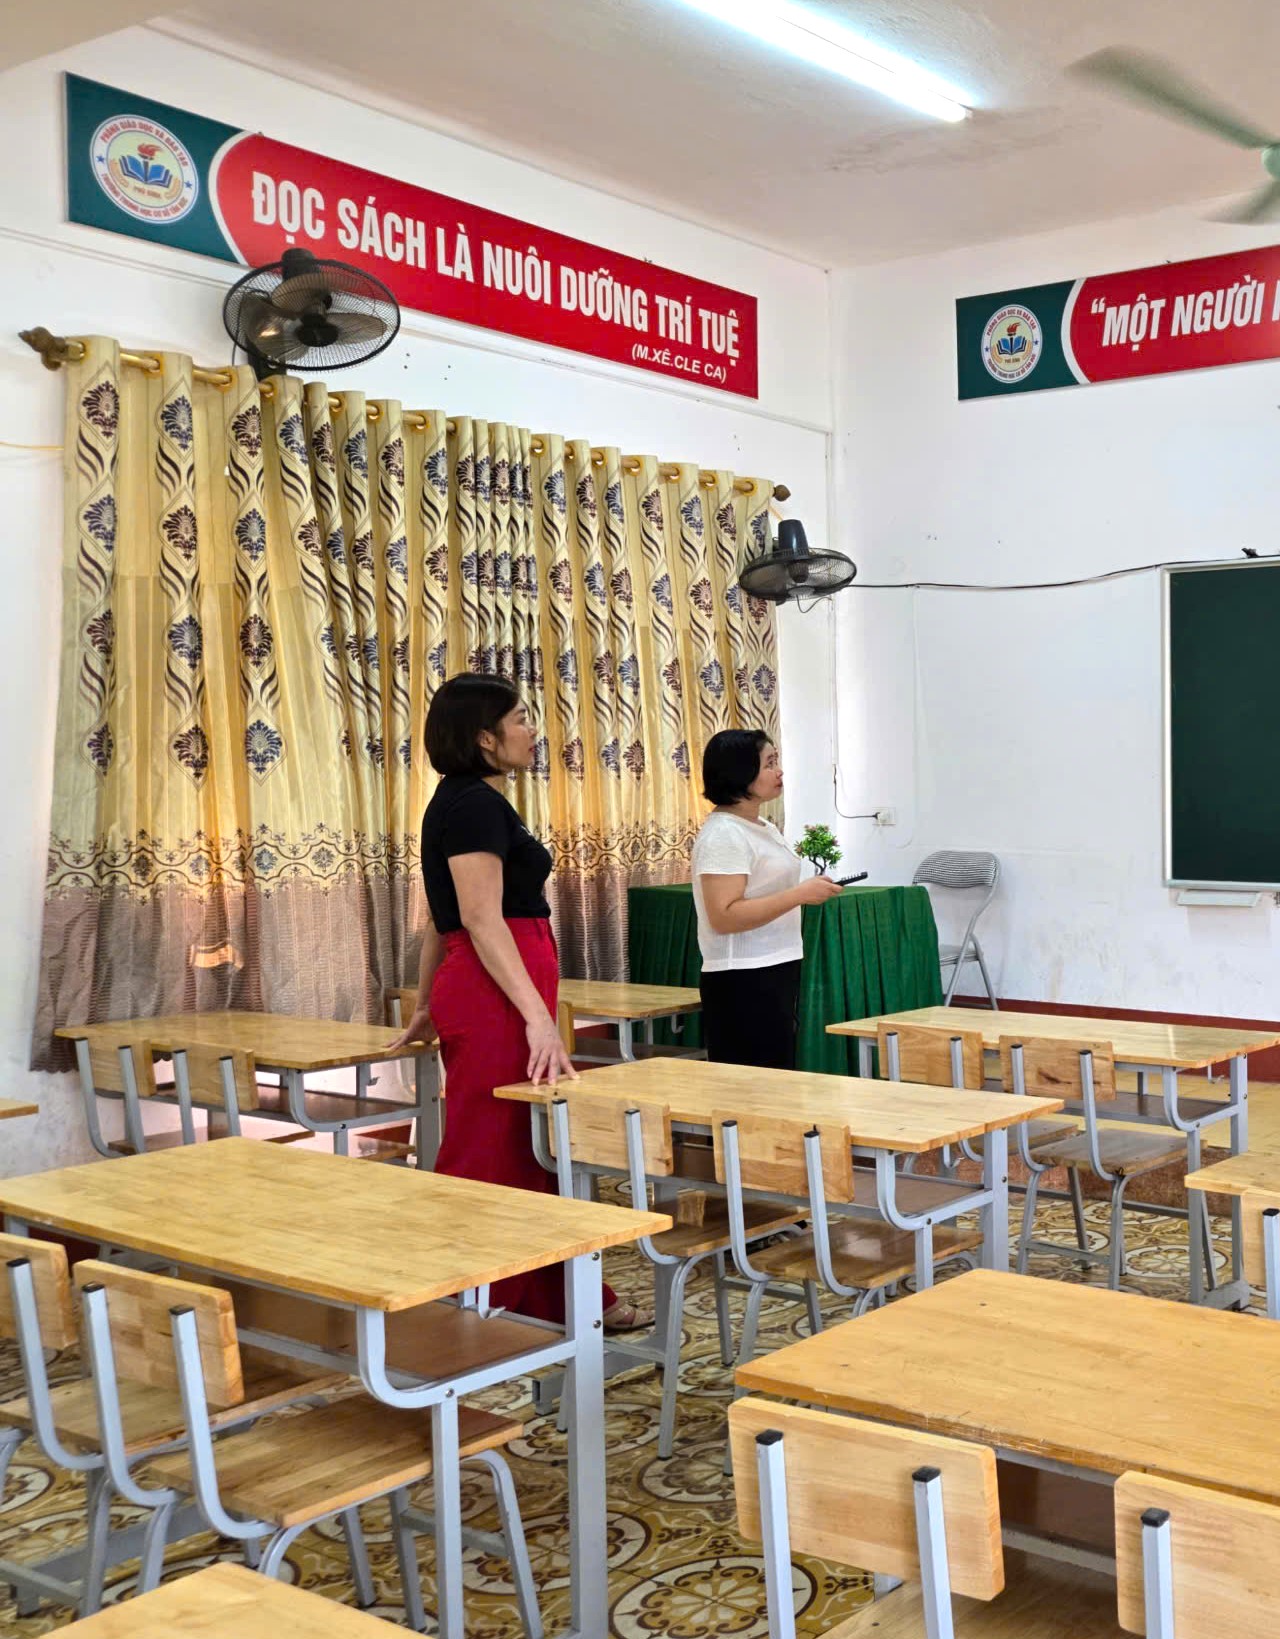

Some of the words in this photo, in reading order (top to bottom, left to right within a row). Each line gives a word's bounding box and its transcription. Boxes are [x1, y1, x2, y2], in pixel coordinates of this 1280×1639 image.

[251, 171, 325, 245] ĐỌC
[337, 196, 427, 269] SÁCH
[436, 222, 475, 283] LÀ
[482, 240, 551, 305] NUÔI
[560, 267, 648, 332] DƯỠNG
[655, 295, 692, 346] TRÍ
[699, 309, 739, 367] TUỆ
[1170, 275, 1265, 337] NGƯỜI
[631, 343, 700, 374] (M.XÊ.CLE
[704, 363, 727, 384] CA)
